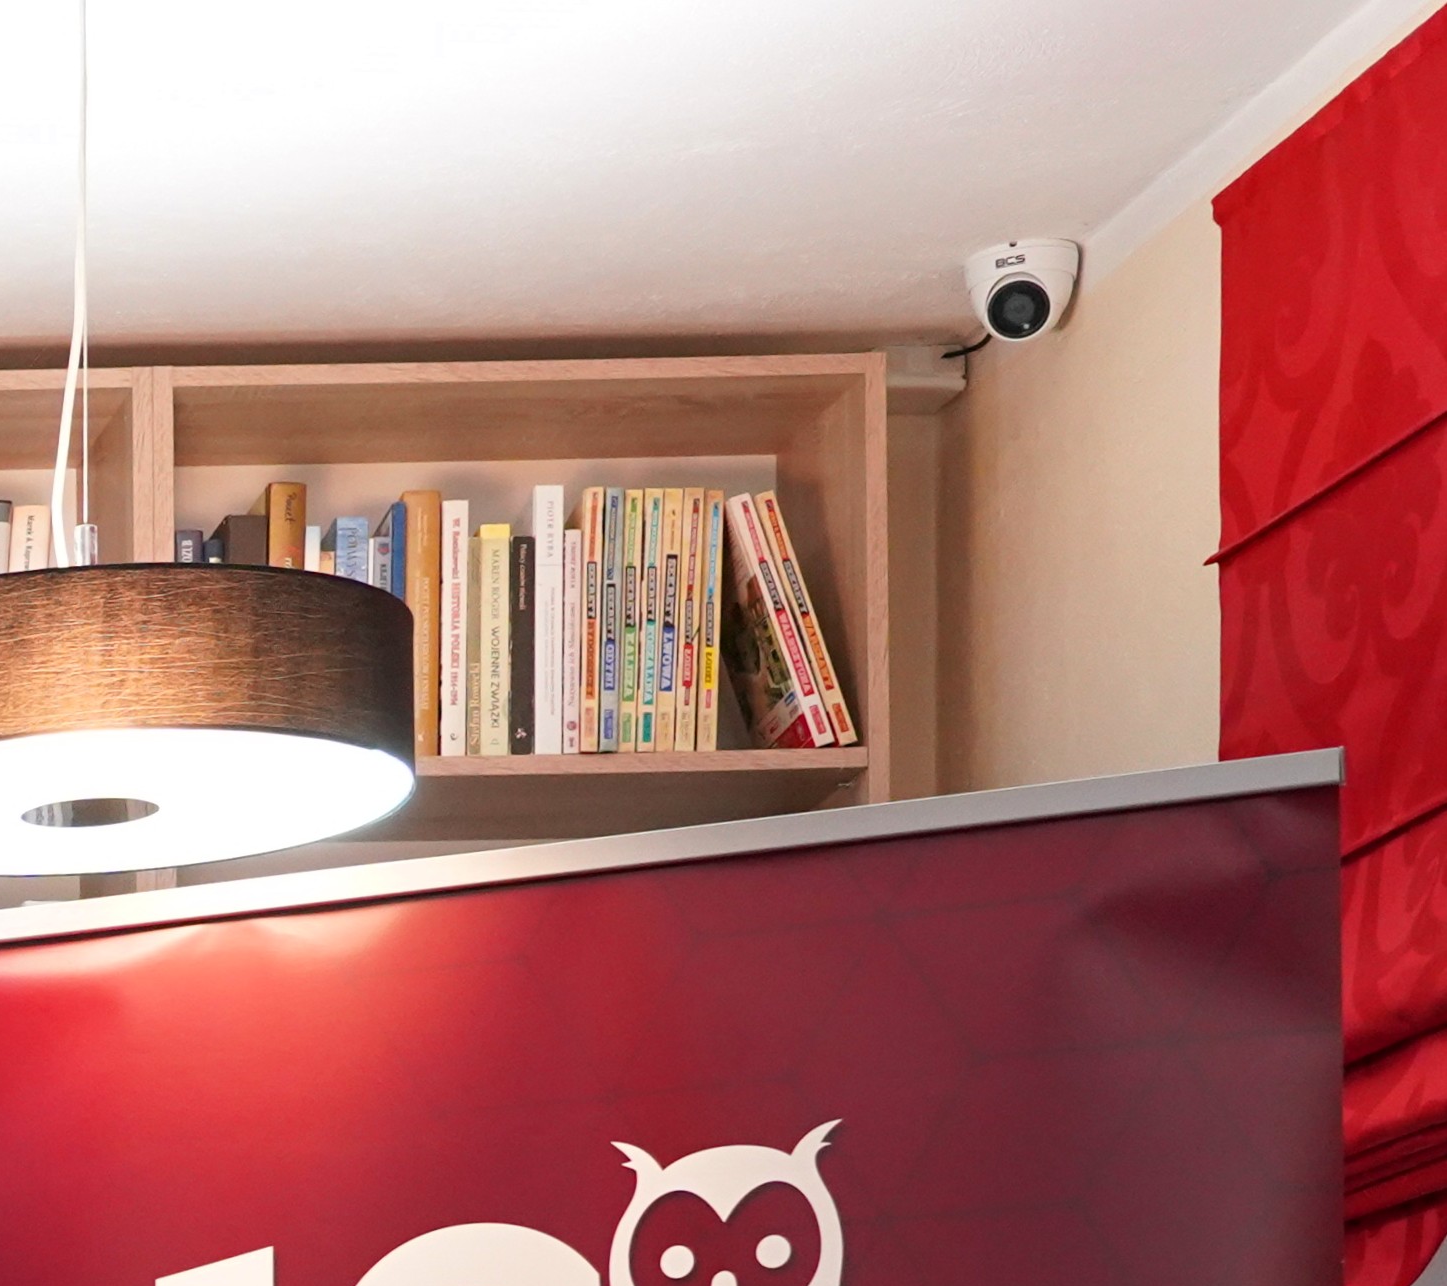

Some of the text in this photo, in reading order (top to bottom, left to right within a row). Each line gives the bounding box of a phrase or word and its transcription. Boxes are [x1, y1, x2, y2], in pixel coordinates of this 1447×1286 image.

[994, 254, 1026, 269] BCS
[490, 626, 502, 729] WOJENNE ZWIĄZKI
